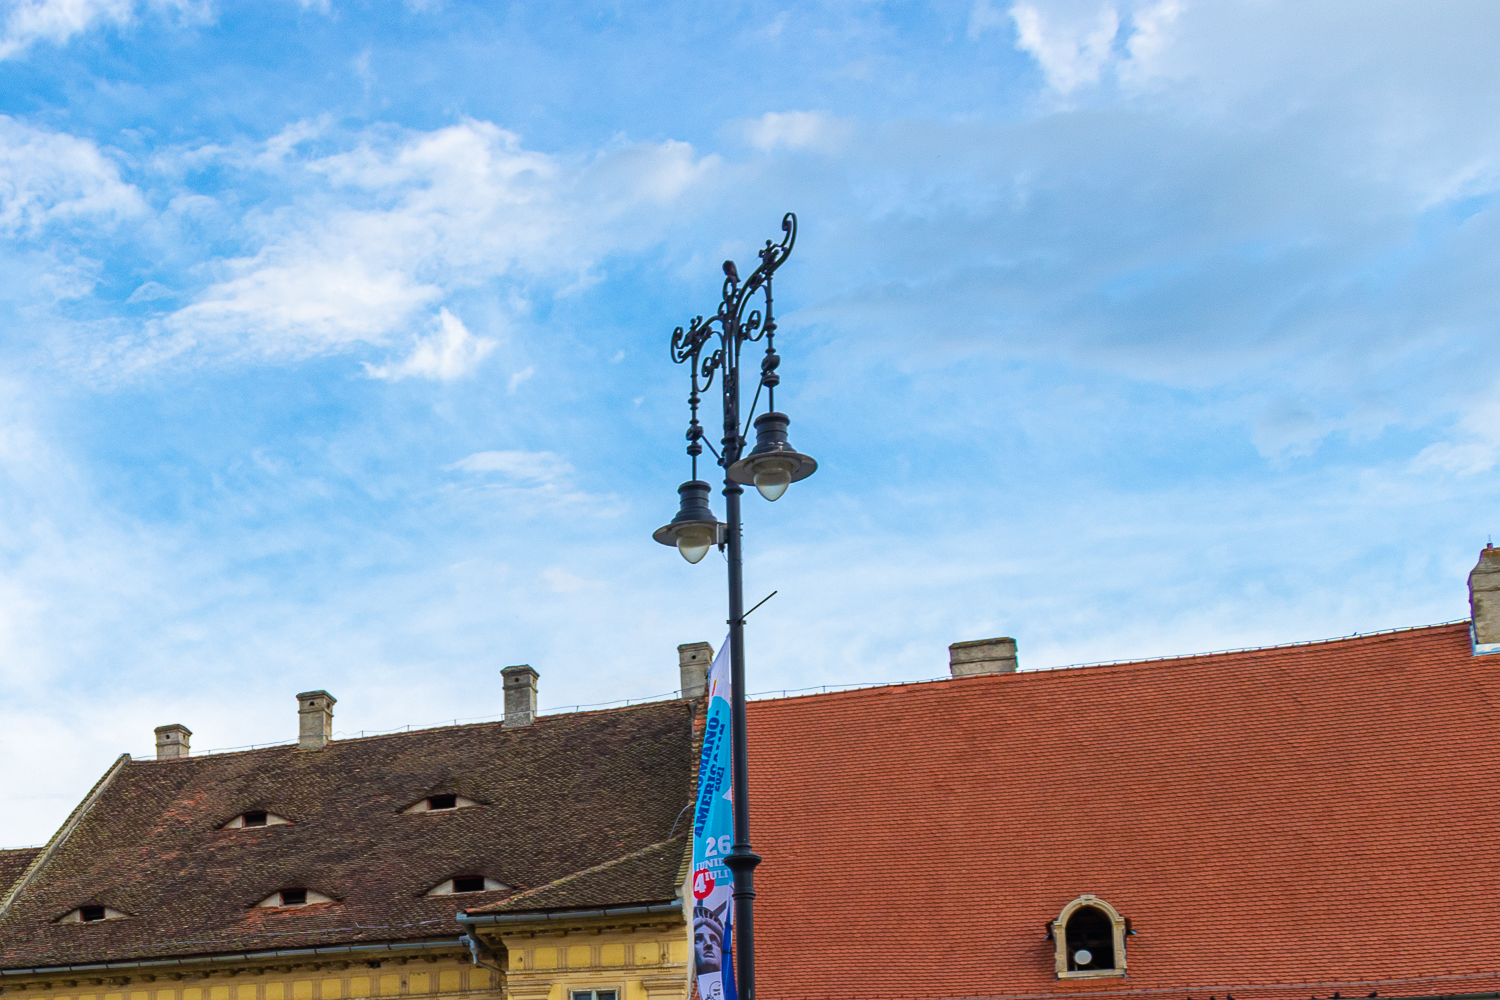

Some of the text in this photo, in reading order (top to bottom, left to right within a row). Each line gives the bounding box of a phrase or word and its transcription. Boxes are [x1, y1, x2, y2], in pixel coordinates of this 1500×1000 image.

[715, 767, 725, 792] 2021
[705, 835, 730, 857] 26
[694, 872, 707, 893] 4
